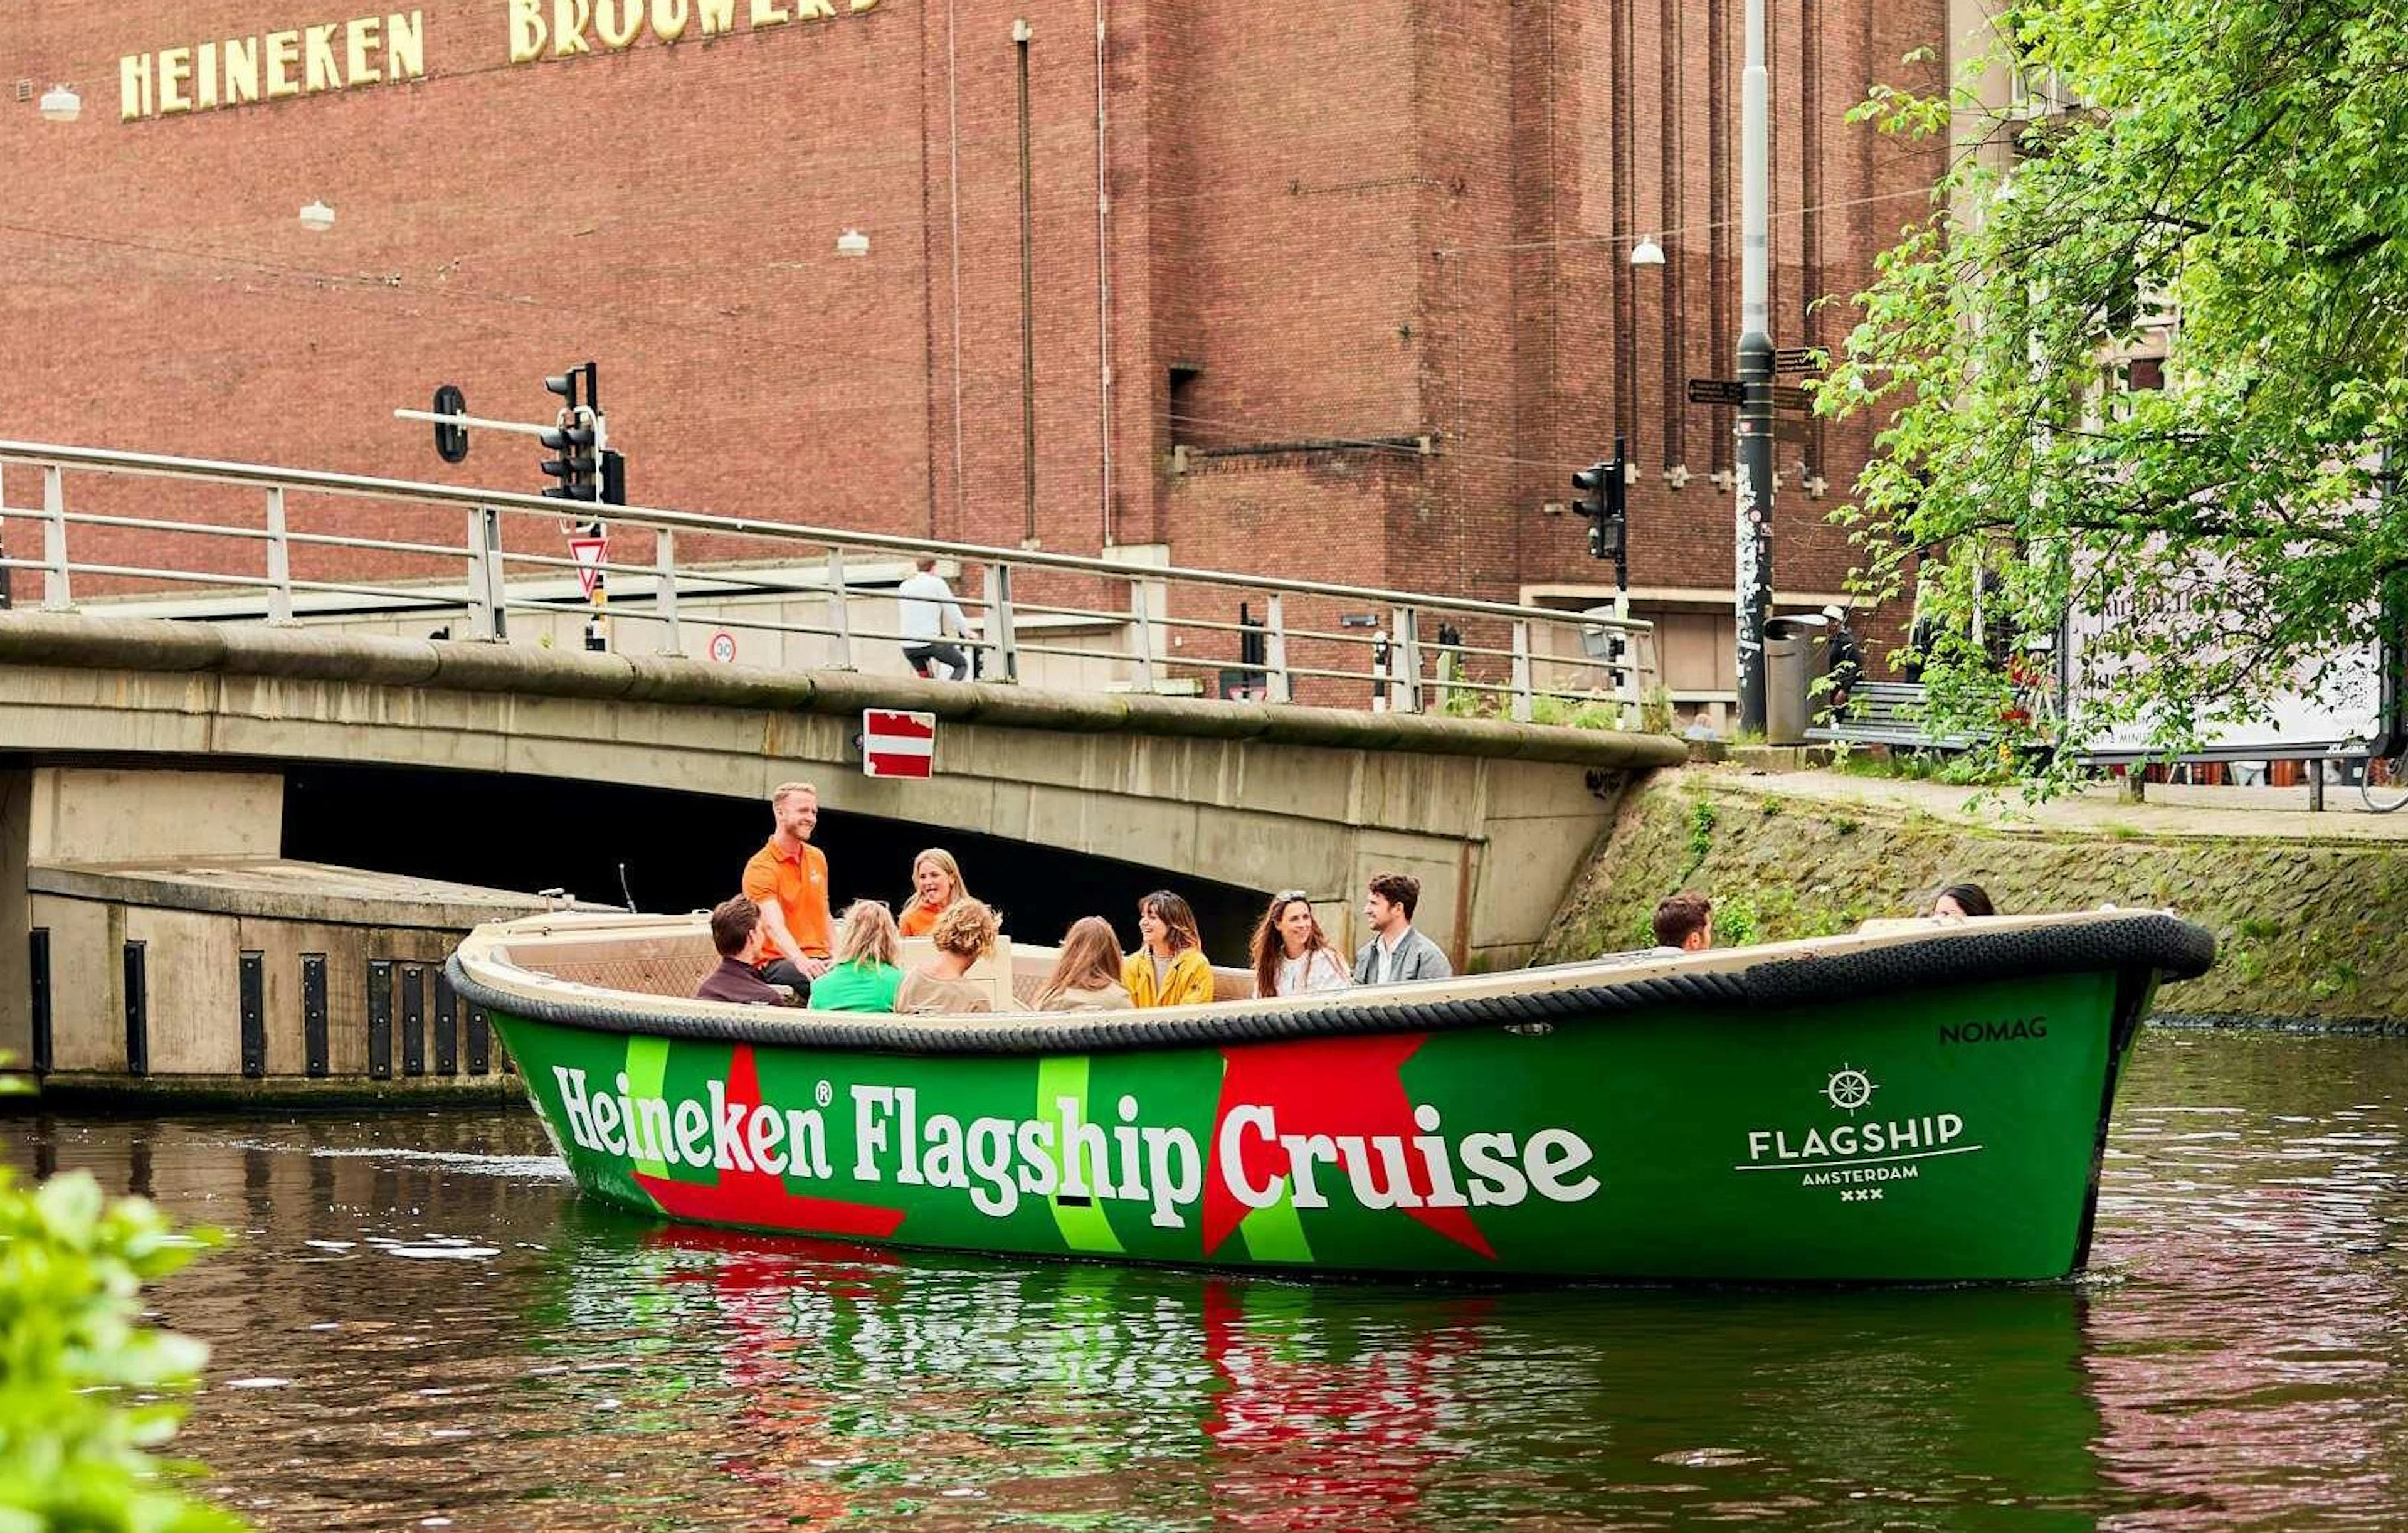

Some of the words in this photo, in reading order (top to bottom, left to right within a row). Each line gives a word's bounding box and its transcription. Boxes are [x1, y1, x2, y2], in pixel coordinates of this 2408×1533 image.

[120, 9, 424, 121] HEINEKEN
[717, 642, 731, 657] 30
[1939, 1016, 2047, 1046] NOMAG
[1748, 1113, 1963, 1160] FLAGSHIP
[850, 1084, 1203, 1228] Flagship
[1219, 1104, 1601, 1209] Cruise
[1802, 1165, 1919, 1186] AMSTERDAM
